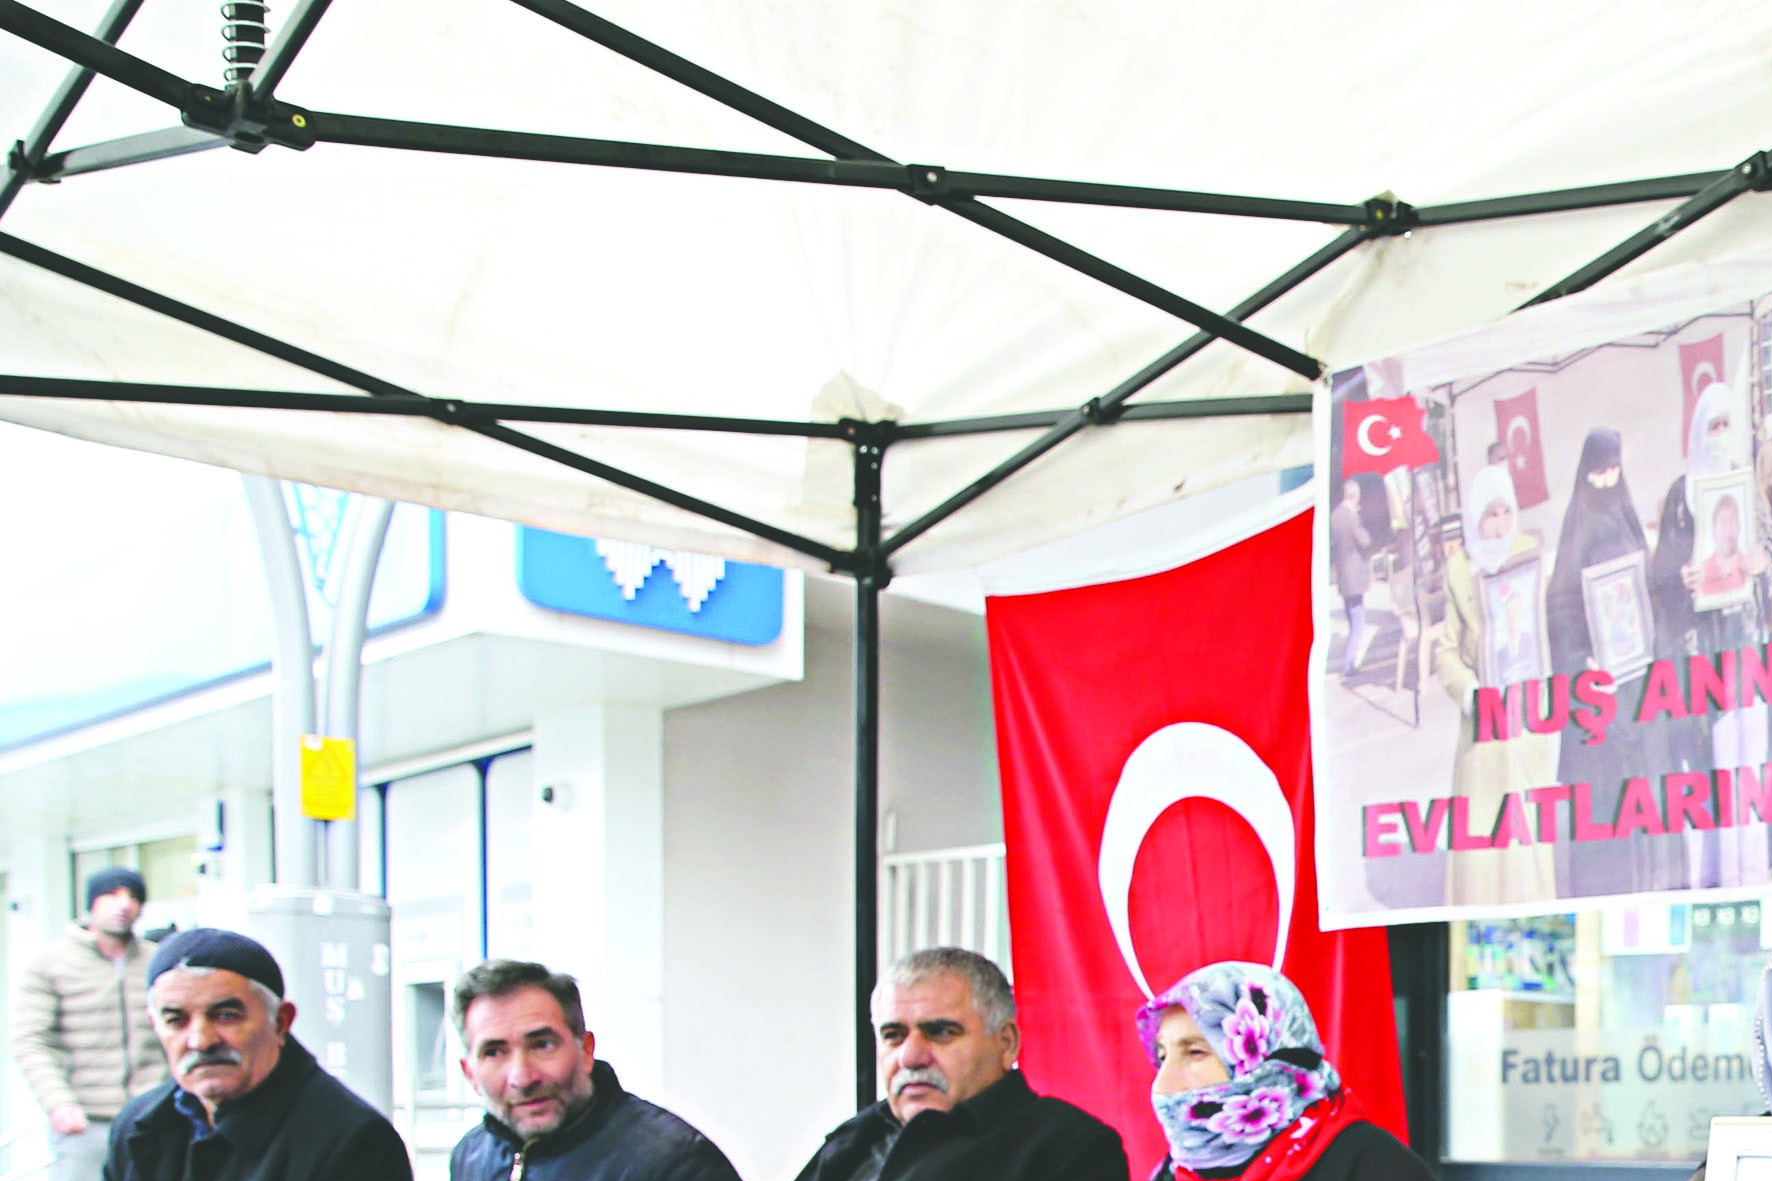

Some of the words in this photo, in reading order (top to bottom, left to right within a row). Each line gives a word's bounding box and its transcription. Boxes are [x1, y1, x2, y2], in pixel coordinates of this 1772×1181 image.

[1474, 669, 1617, 746] MUŞ
[1501, 1048, 1621, 1084] Fatura
[1638, 1035, 1753, 1082] Ödem
